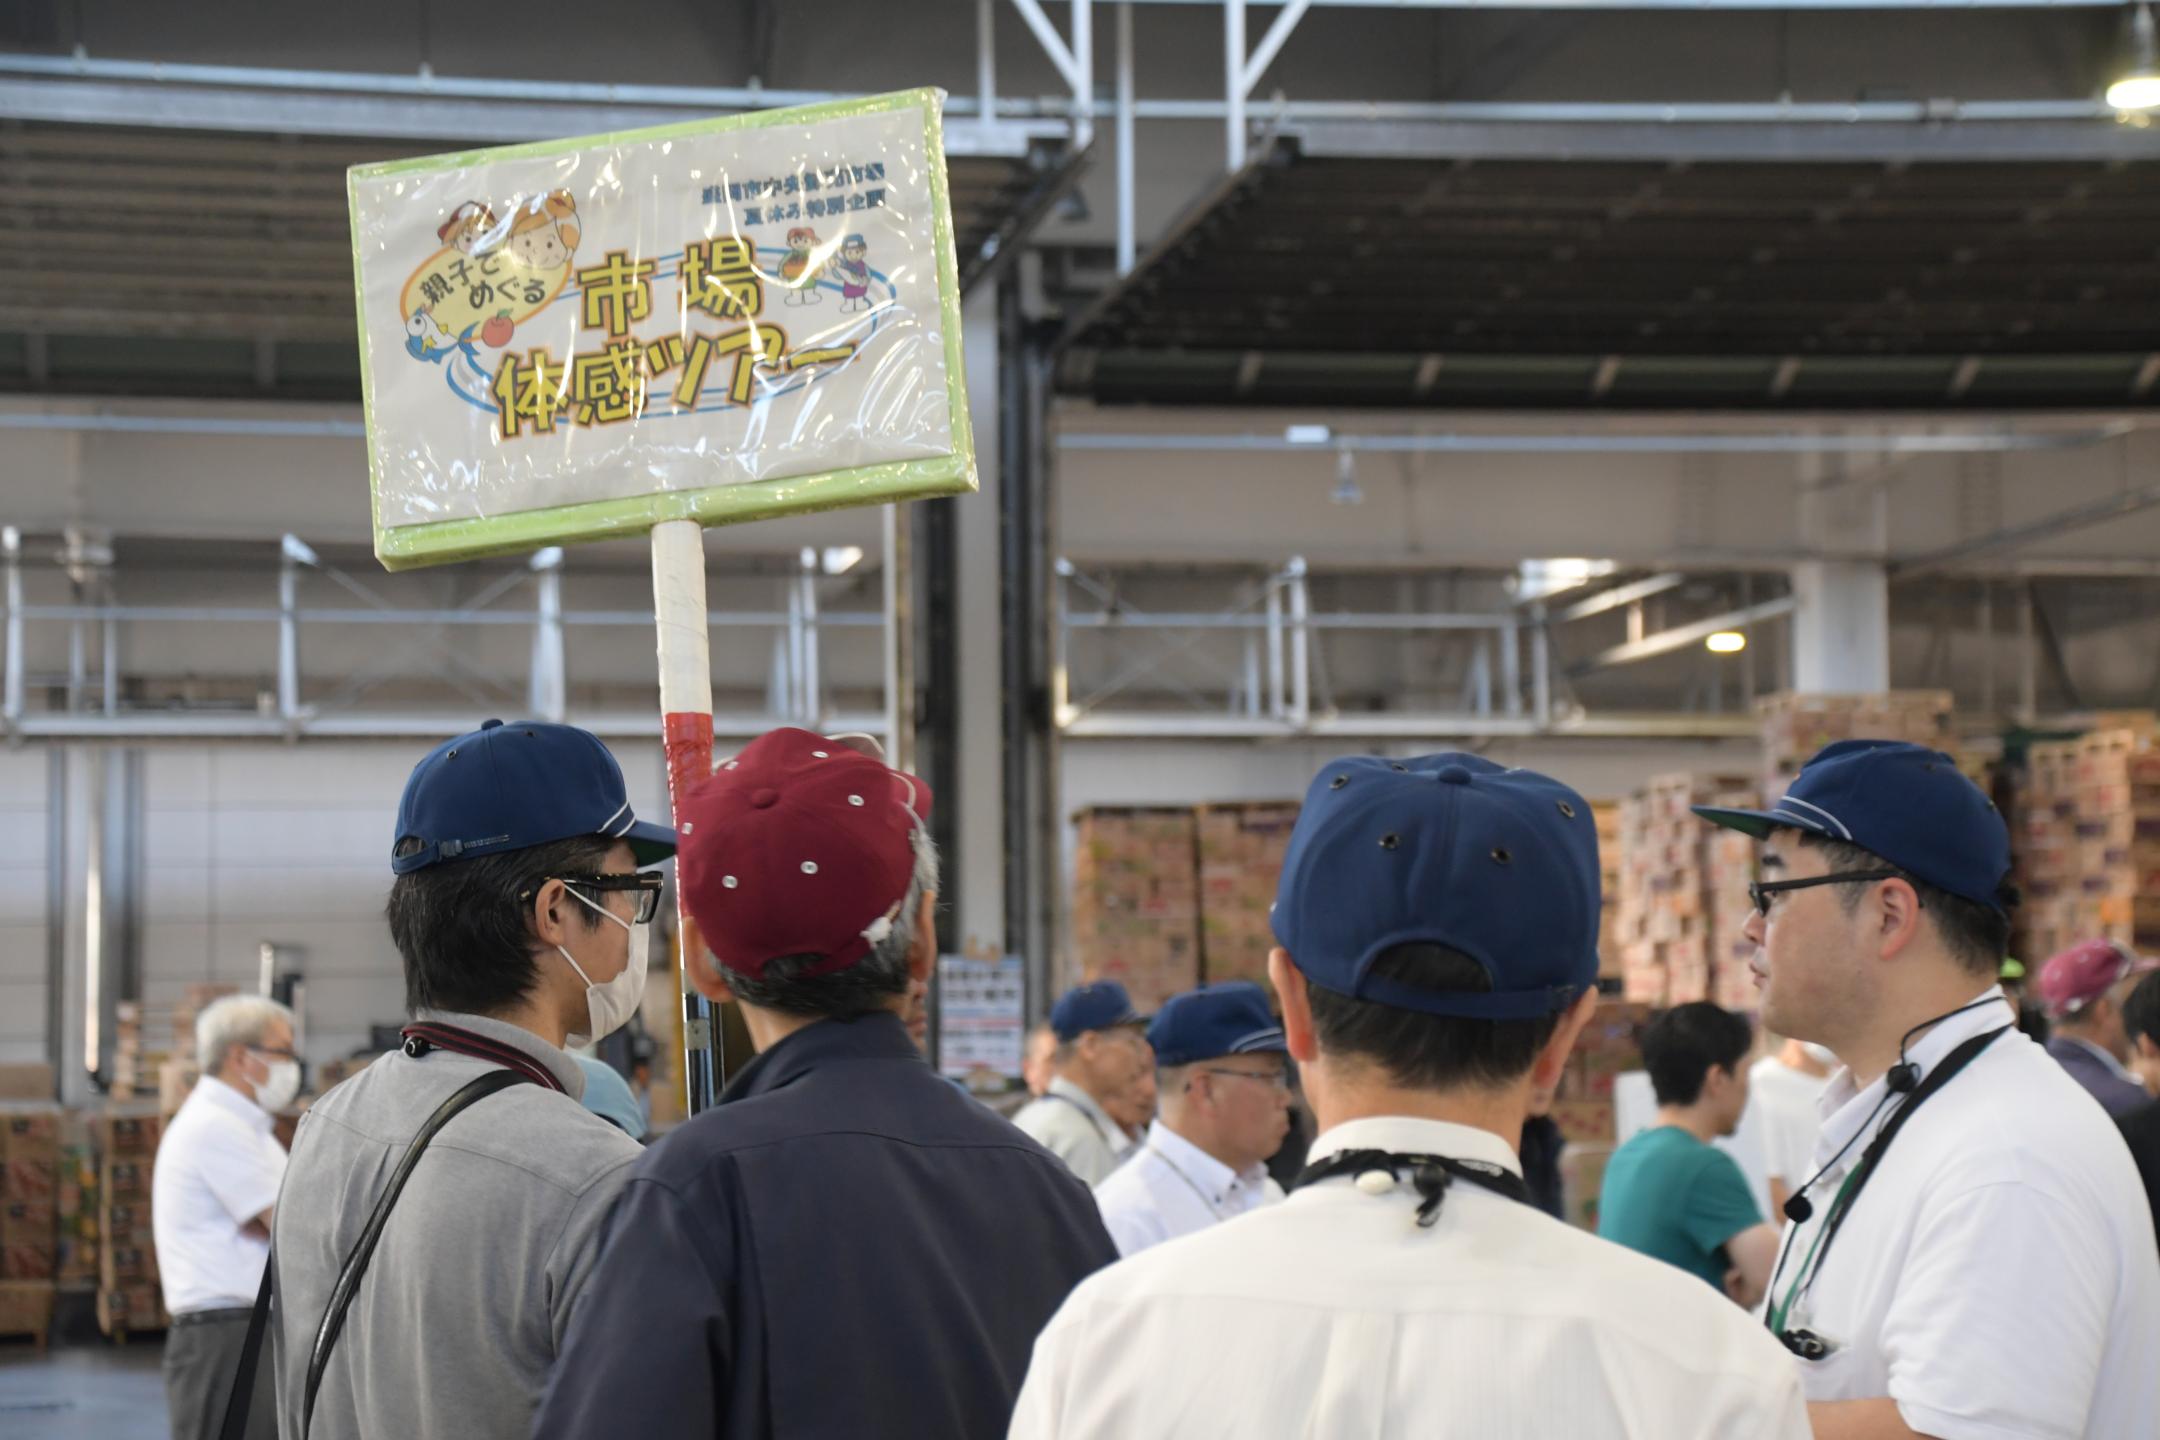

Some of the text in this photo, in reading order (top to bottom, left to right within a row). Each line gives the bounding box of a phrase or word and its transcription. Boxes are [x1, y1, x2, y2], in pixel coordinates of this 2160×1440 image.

[419, 251, 500, 307] 親子で
[469, 276, 546, 309] めぐる
[575, 236, 764, 338] 市場
[492, 323, 860, 439] 体感ツアー
